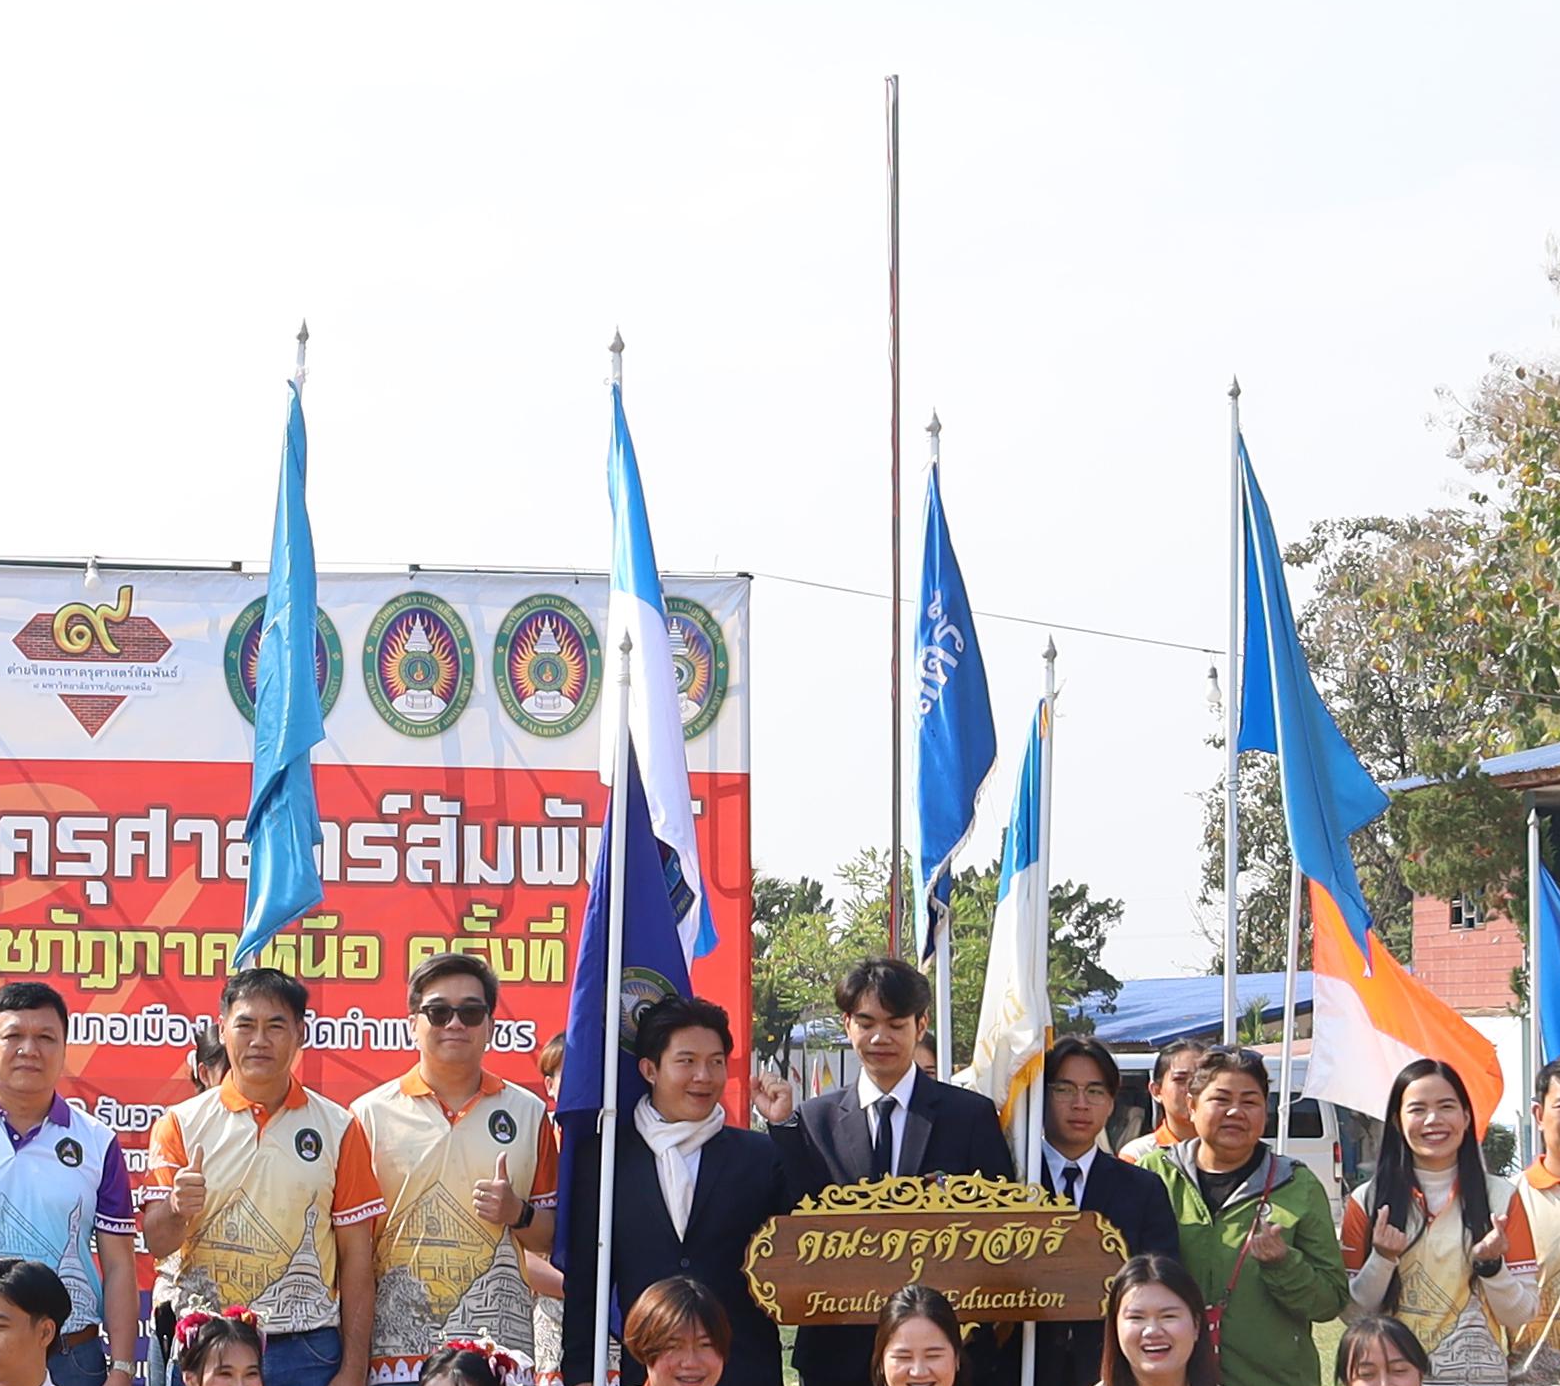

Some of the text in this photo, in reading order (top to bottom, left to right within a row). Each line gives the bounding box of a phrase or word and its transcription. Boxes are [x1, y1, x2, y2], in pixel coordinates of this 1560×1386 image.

[797, 1215, 1079, 1284] คณะครุศาสตร์
